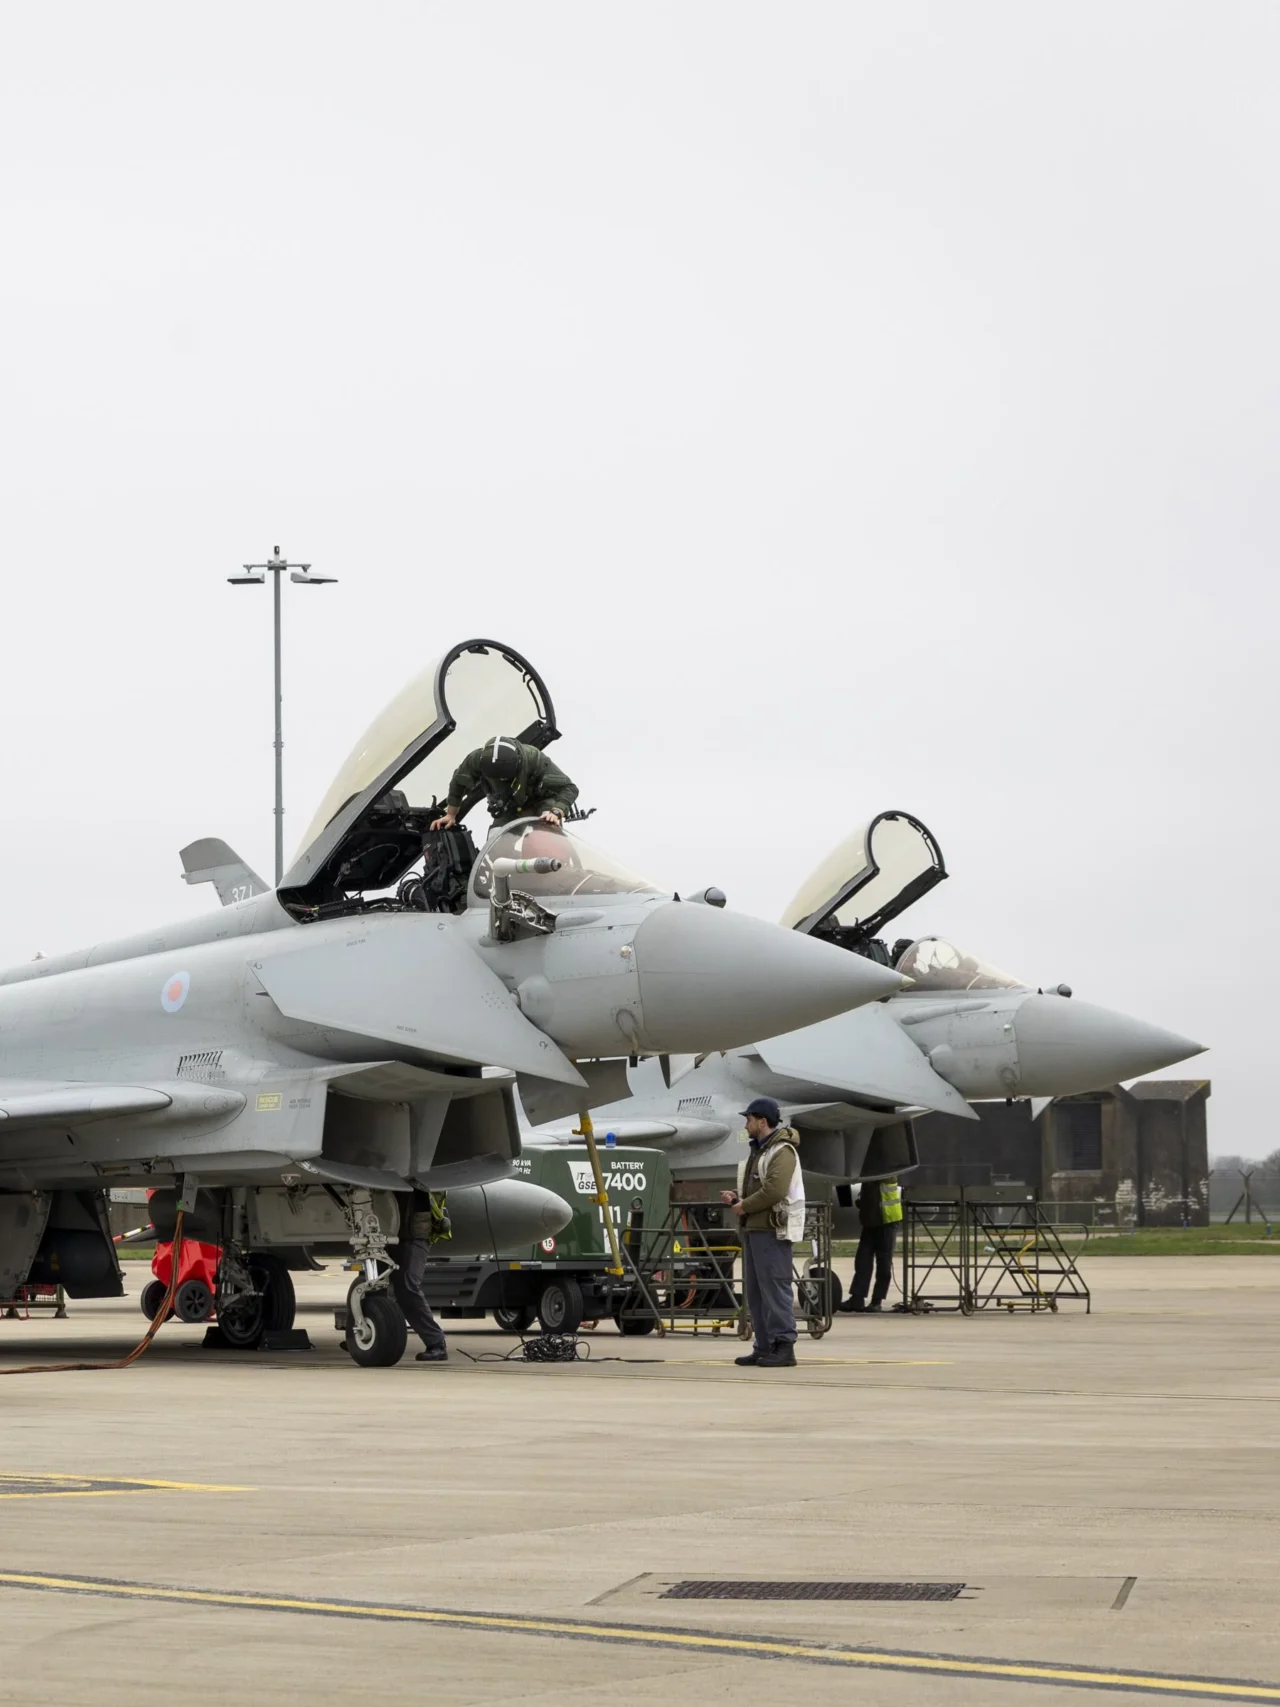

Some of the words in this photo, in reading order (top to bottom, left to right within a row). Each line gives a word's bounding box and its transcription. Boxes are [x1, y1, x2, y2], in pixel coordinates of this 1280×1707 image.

[520, 1159, 532, 1167] kVA
[611, 1161, 644, 1169] BATTERY
[523, 1167, 532, 1175] Hz
[578, 1181, 596, 1190] GSE
[602, 1173, 646, 1191] 7400
[544, 1240, 553, 1248] 15
